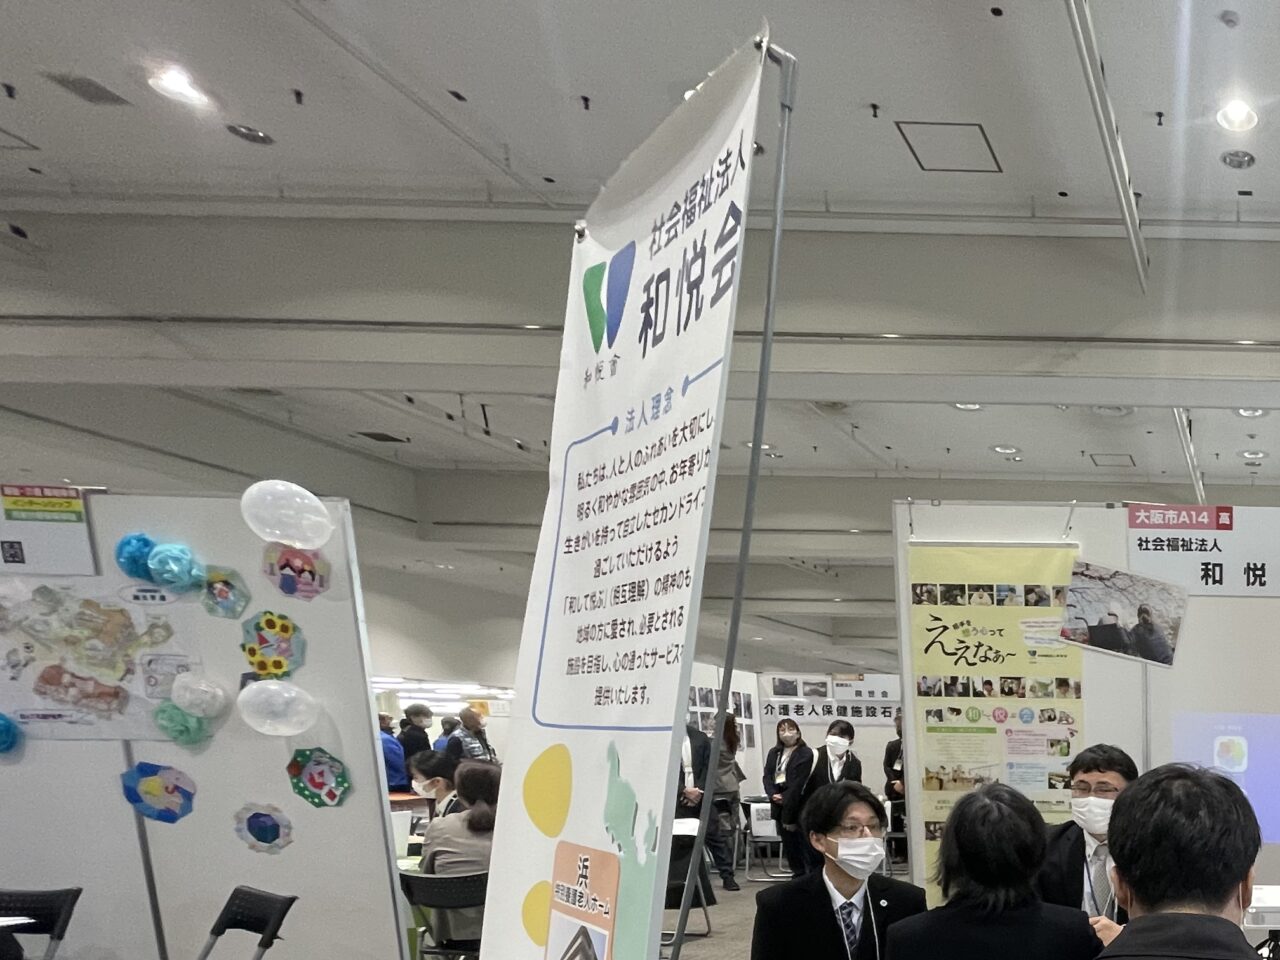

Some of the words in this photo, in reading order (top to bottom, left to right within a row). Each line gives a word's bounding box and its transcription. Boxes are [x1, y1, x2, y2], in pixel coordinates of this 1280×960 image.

[649, 129, 746, 260] 社会福祉法人
[638, 200, 743, 358] 和悦会
[624, 386, 674, 434] 法人理念
[1135, 510, 1209, 525] 大阪市A14
[593, 536, 678, 579] 過ごしていただけるよう
[1137, 537, 1222, 553] 社会福祉法人
[594, 685, 651, 708] 提供いたします。
